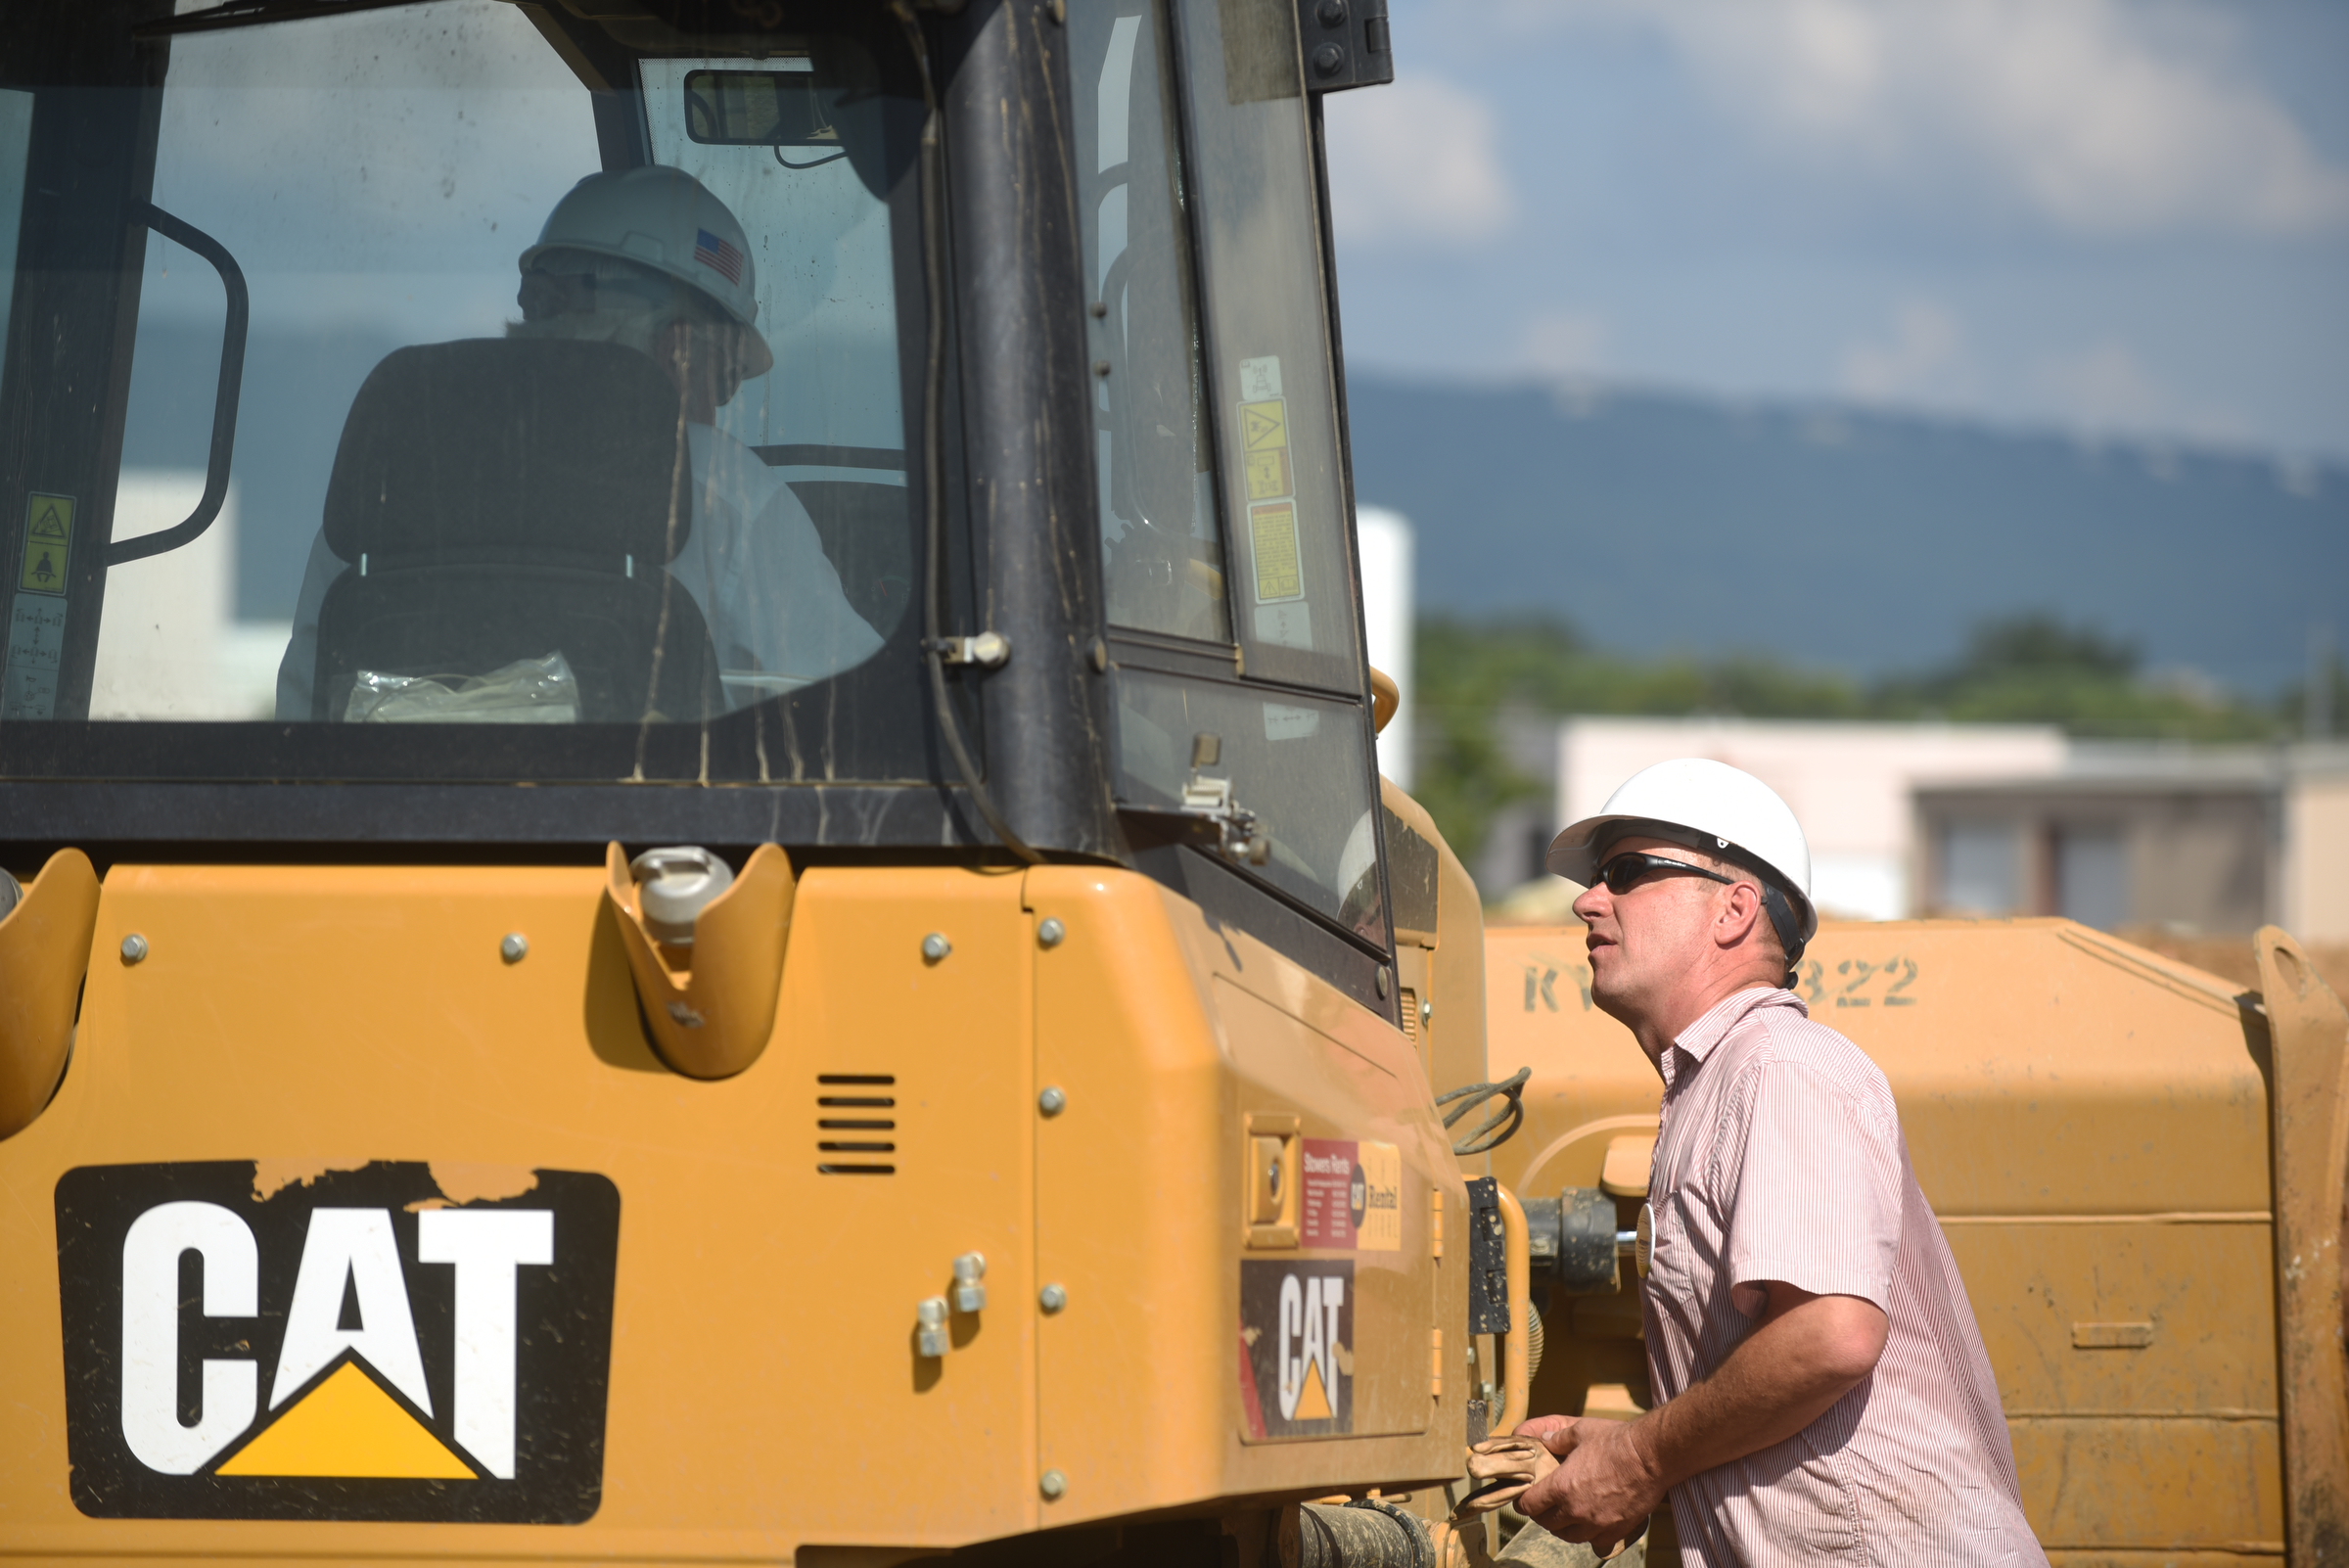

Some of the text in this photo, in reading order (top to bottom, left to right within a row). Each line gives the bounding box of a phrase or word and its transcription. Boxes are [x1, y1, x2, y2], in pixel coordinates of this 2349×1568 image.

[1368, 1185, 1398, 1210] Rental
[121, 1200, 554, 1480] CAT
[1278, 1272, 1345, 1421] CAT
